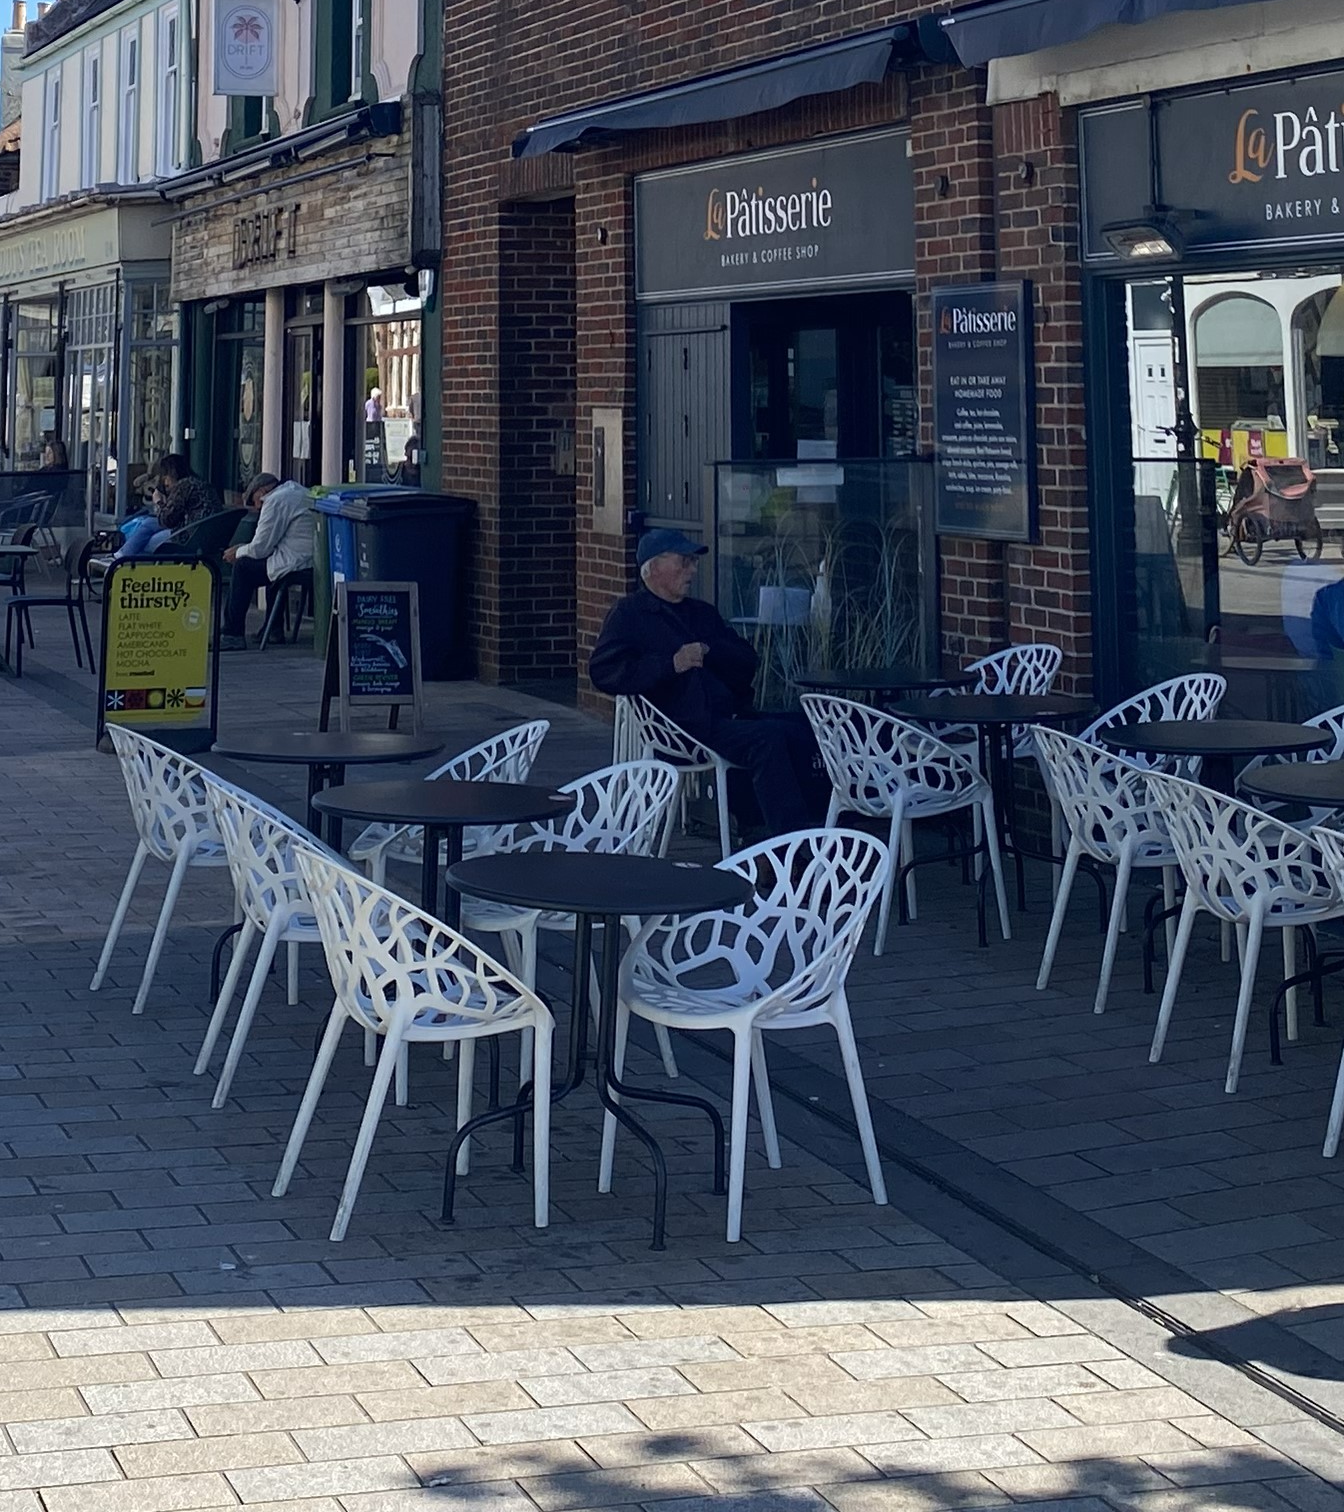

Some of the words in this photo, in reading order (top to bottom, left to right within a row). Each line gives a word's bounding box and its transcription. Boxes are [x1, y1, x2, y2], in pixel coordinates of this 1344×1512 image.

[227, 44, 265, 57] DRIFT
[1228, 109, 1274, 184] La
[704, 188, 726, 240] La
[726, 177, 832, 238] Pâtisserie
[1266, 198, 1322, 221] BAKERY
[1330, 197, 1340, 214] &
[721, 253, 749, 267] BAKERY
[752, 251, 758, 264] &
[761, 248, 792, 264] COFFEE
[796, 244, 819, 260] SHOP
[952, 305, 1016, 334] Pâtisserie
[121, 577, 185, 596] Feeling
[120, 592, 191, 611] thirsty?
[118, 612, 141, 622] LATTE
[118, 622, 137, 631] FLAT
[138, 621, 162, 630] WHITE
[117, 630, 176, 640] CAPPUCCINO
[117, 640, 169, 649] AMERICANO
[117, 649, 134, 659] HOT
[135, 648, 187, 658] CHOCOLATE
[116, 659, 150, 668] MOCHA
